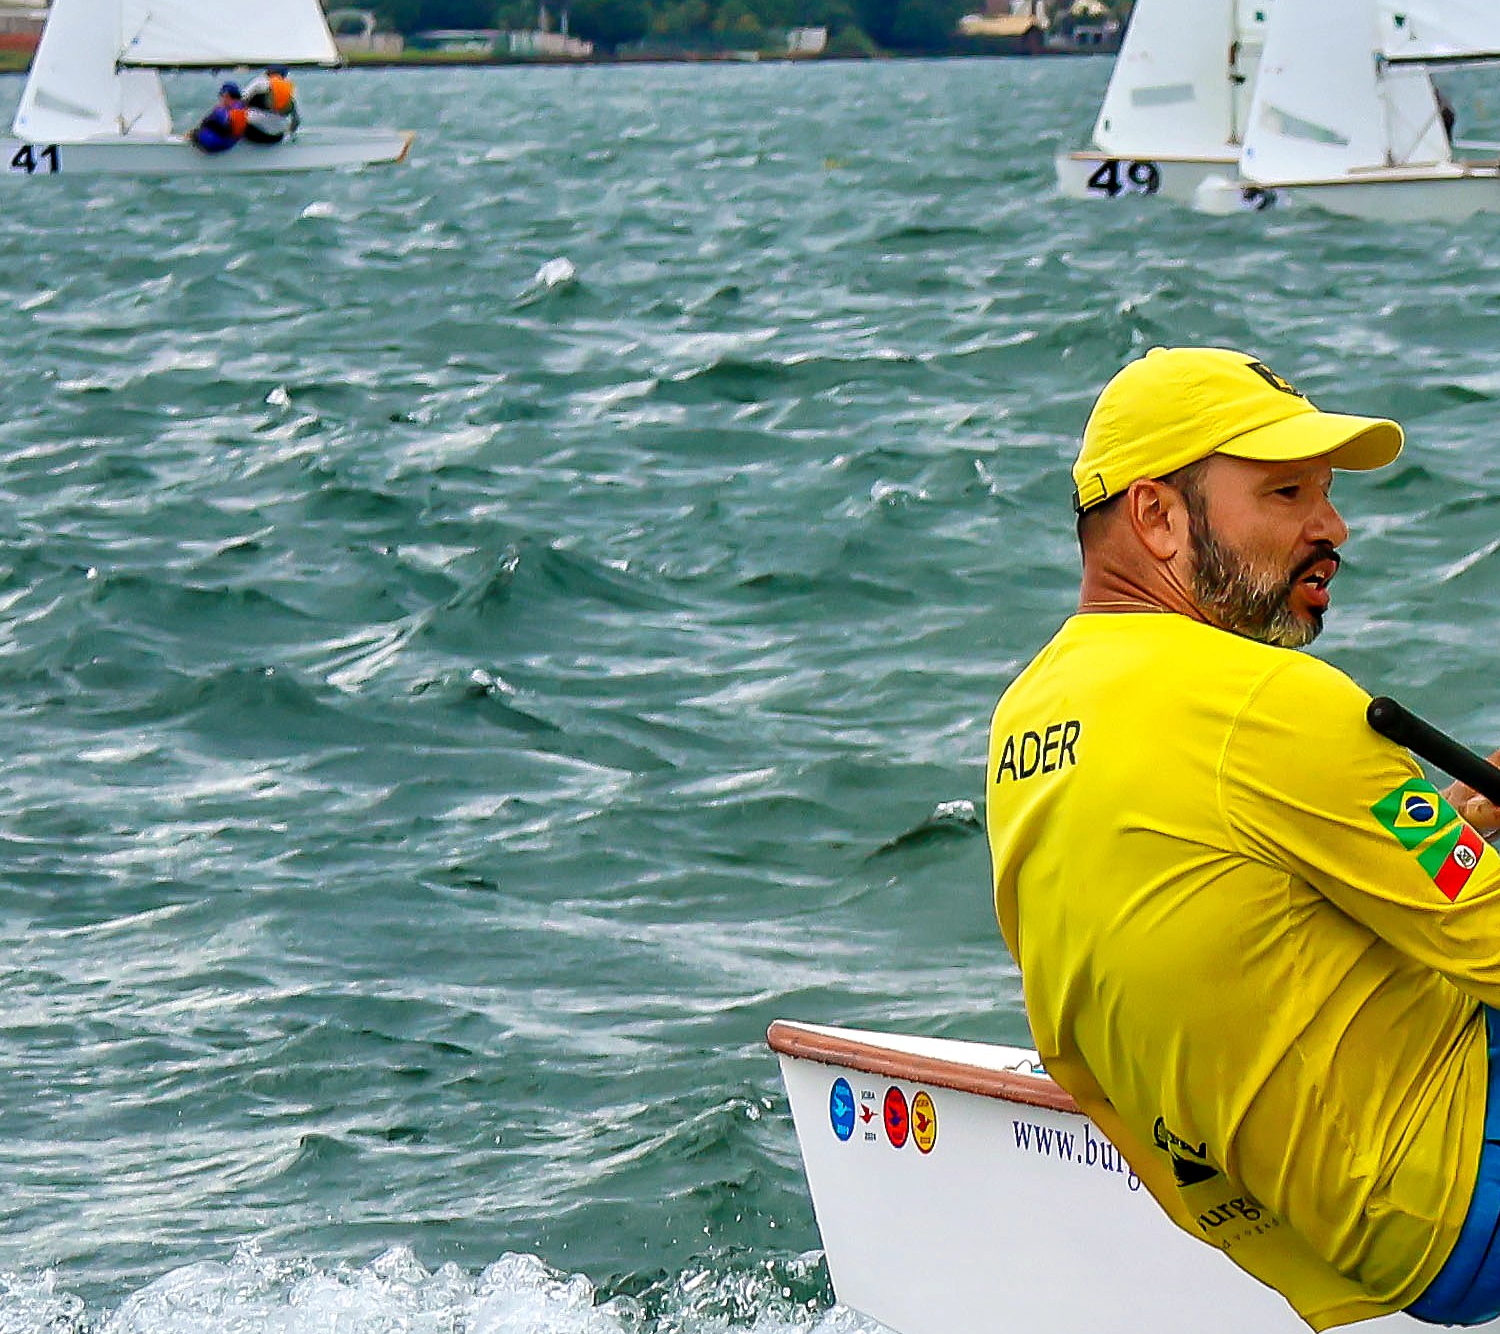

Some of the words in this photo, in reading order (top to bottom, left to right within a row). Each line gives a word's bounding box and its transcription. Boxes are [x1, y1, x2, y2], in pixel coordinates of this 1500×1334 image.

[11, 144, 59, 174] 41
[1088, 158, 1160, 196] 49
[996, 720, 1081, 784] ADER
